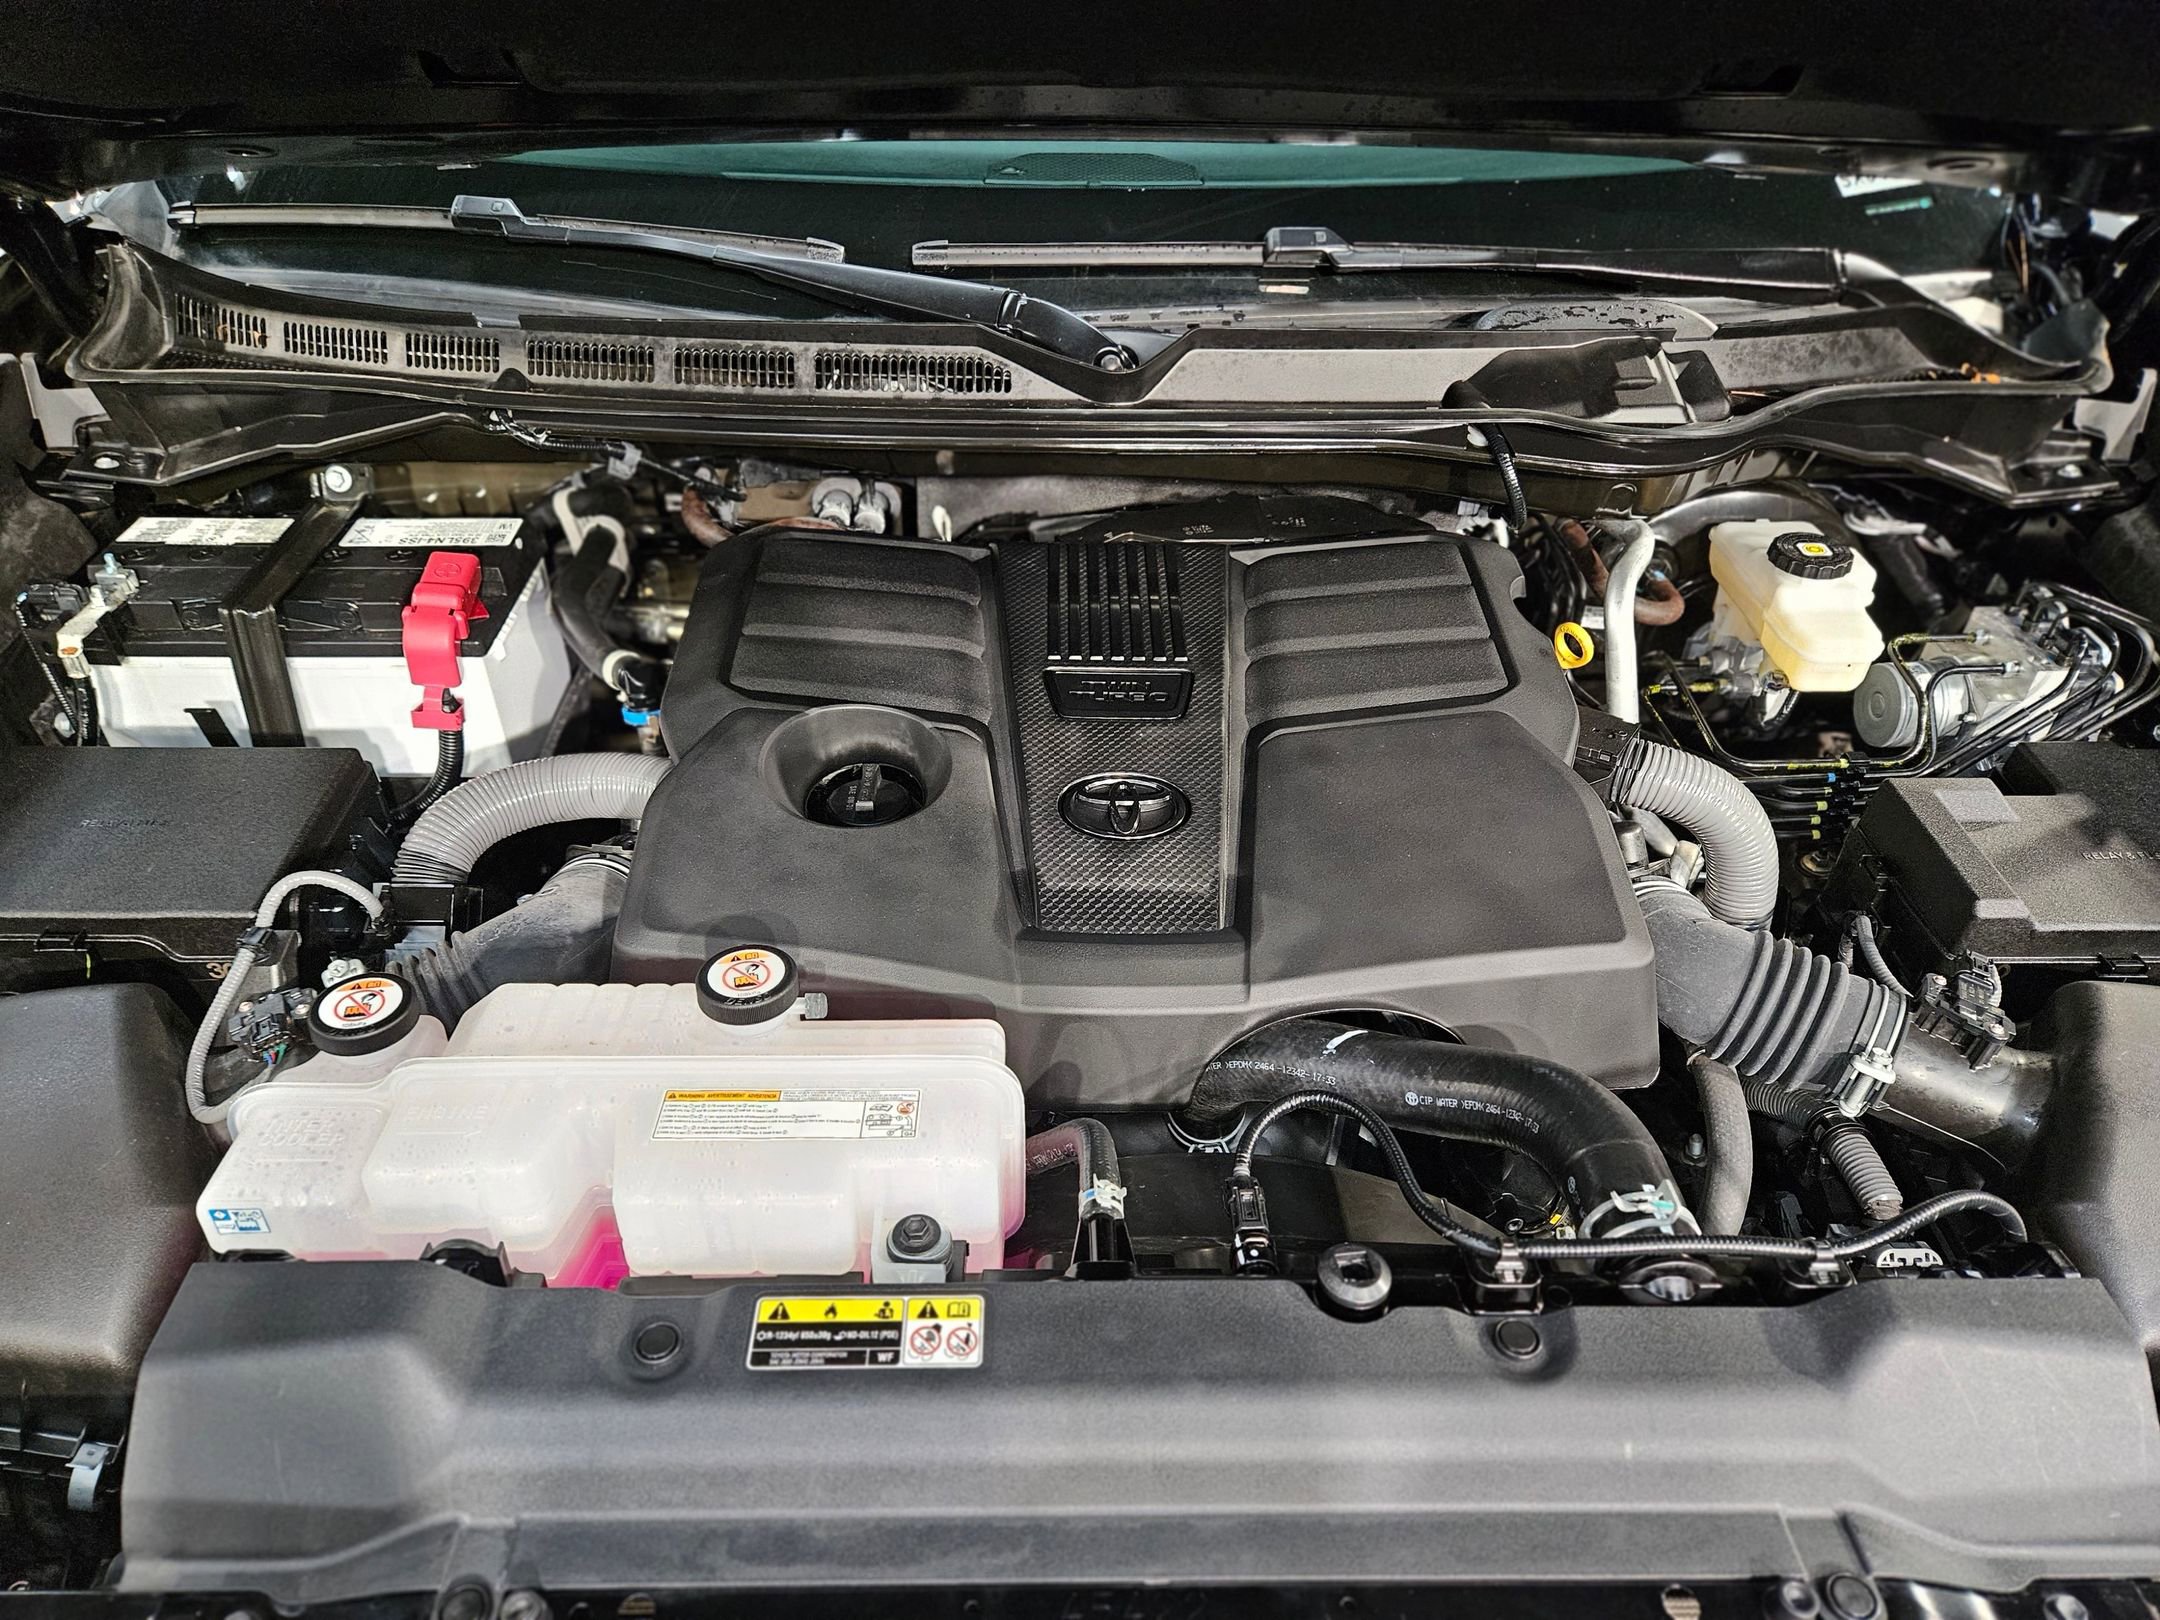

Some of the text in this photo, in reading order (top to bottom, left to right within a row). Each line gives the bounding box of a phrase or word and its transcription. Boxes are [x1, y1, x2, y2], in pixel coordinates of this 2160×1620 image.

[2081, 851, 2124, 861] RELAY
[1436, 1098, 1458, 1108] WATER
[406, 1105, 489, 1120] ENGINE
[877, 1352, 894, 1363] WF
